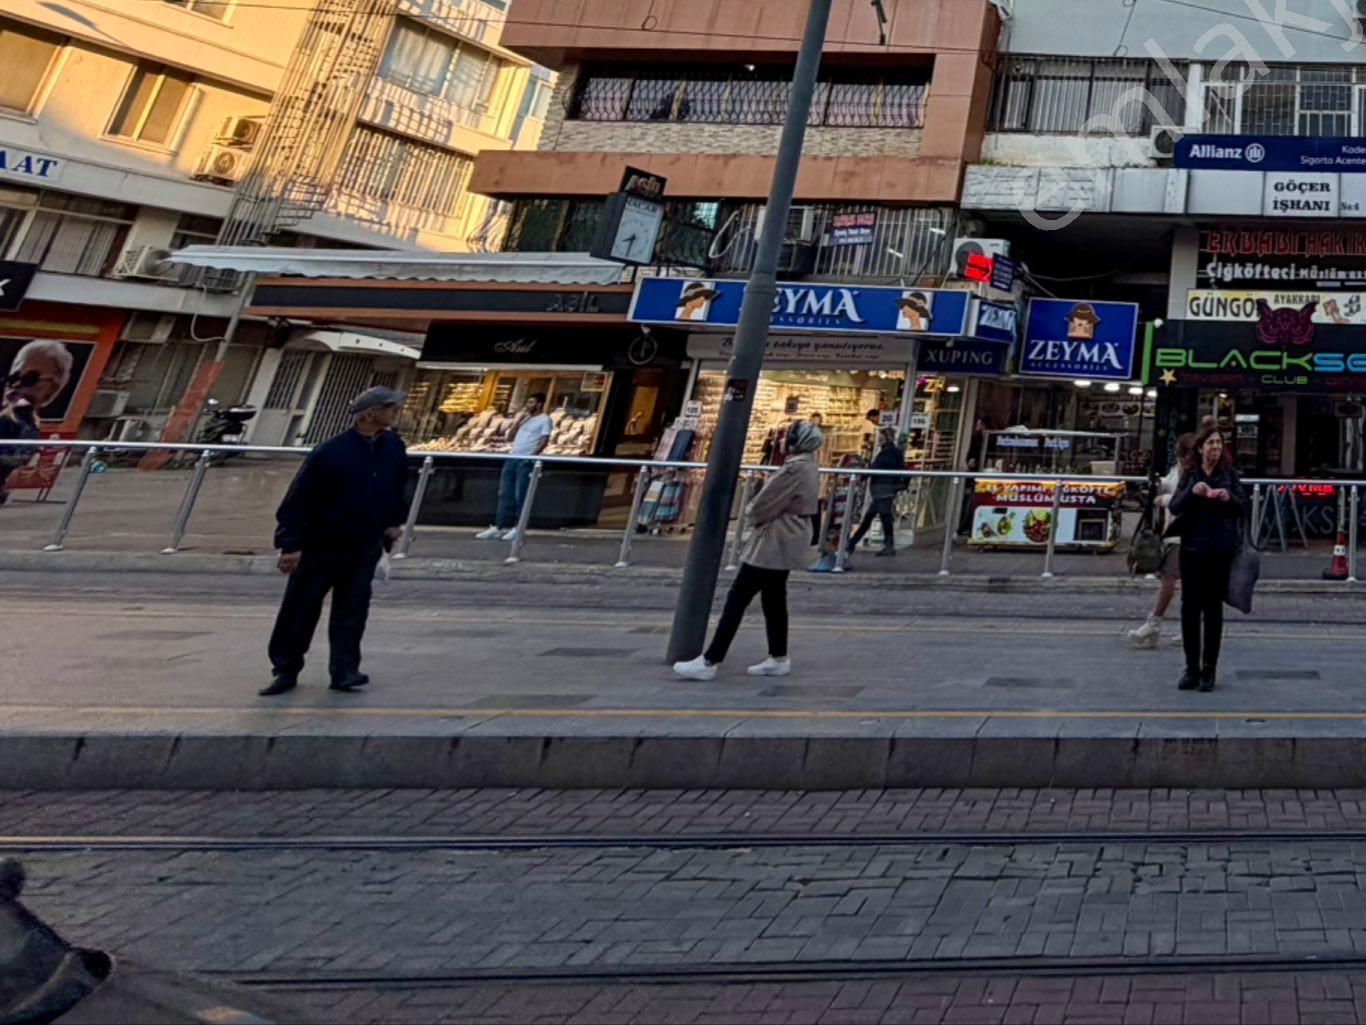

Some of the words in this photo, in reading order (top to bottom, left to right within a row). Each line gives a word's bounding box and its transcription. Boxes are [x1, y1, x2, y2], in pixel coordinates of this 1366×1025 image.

[1188, 143, 1243, 160] Allianz
[1300, 155, 1334, 167] Sigorta
[1273, 179, 1331, 194] GÖÇER
[1272, 197, 1331, 214] İŞHANI
[1206, 261, 1296, 283] Çiğköfteci
[1189, 292, 1262, 318] GÜNGÖ
[925, 348, 994, 366] XUPING
[1027, 339, 1124, 370] ZEYMA
[1261, 374, 1309, 386] CLUB
[995, 492, 1057, 503] MÜSLÜM
[1060, 494, 1097, 505] USTA
